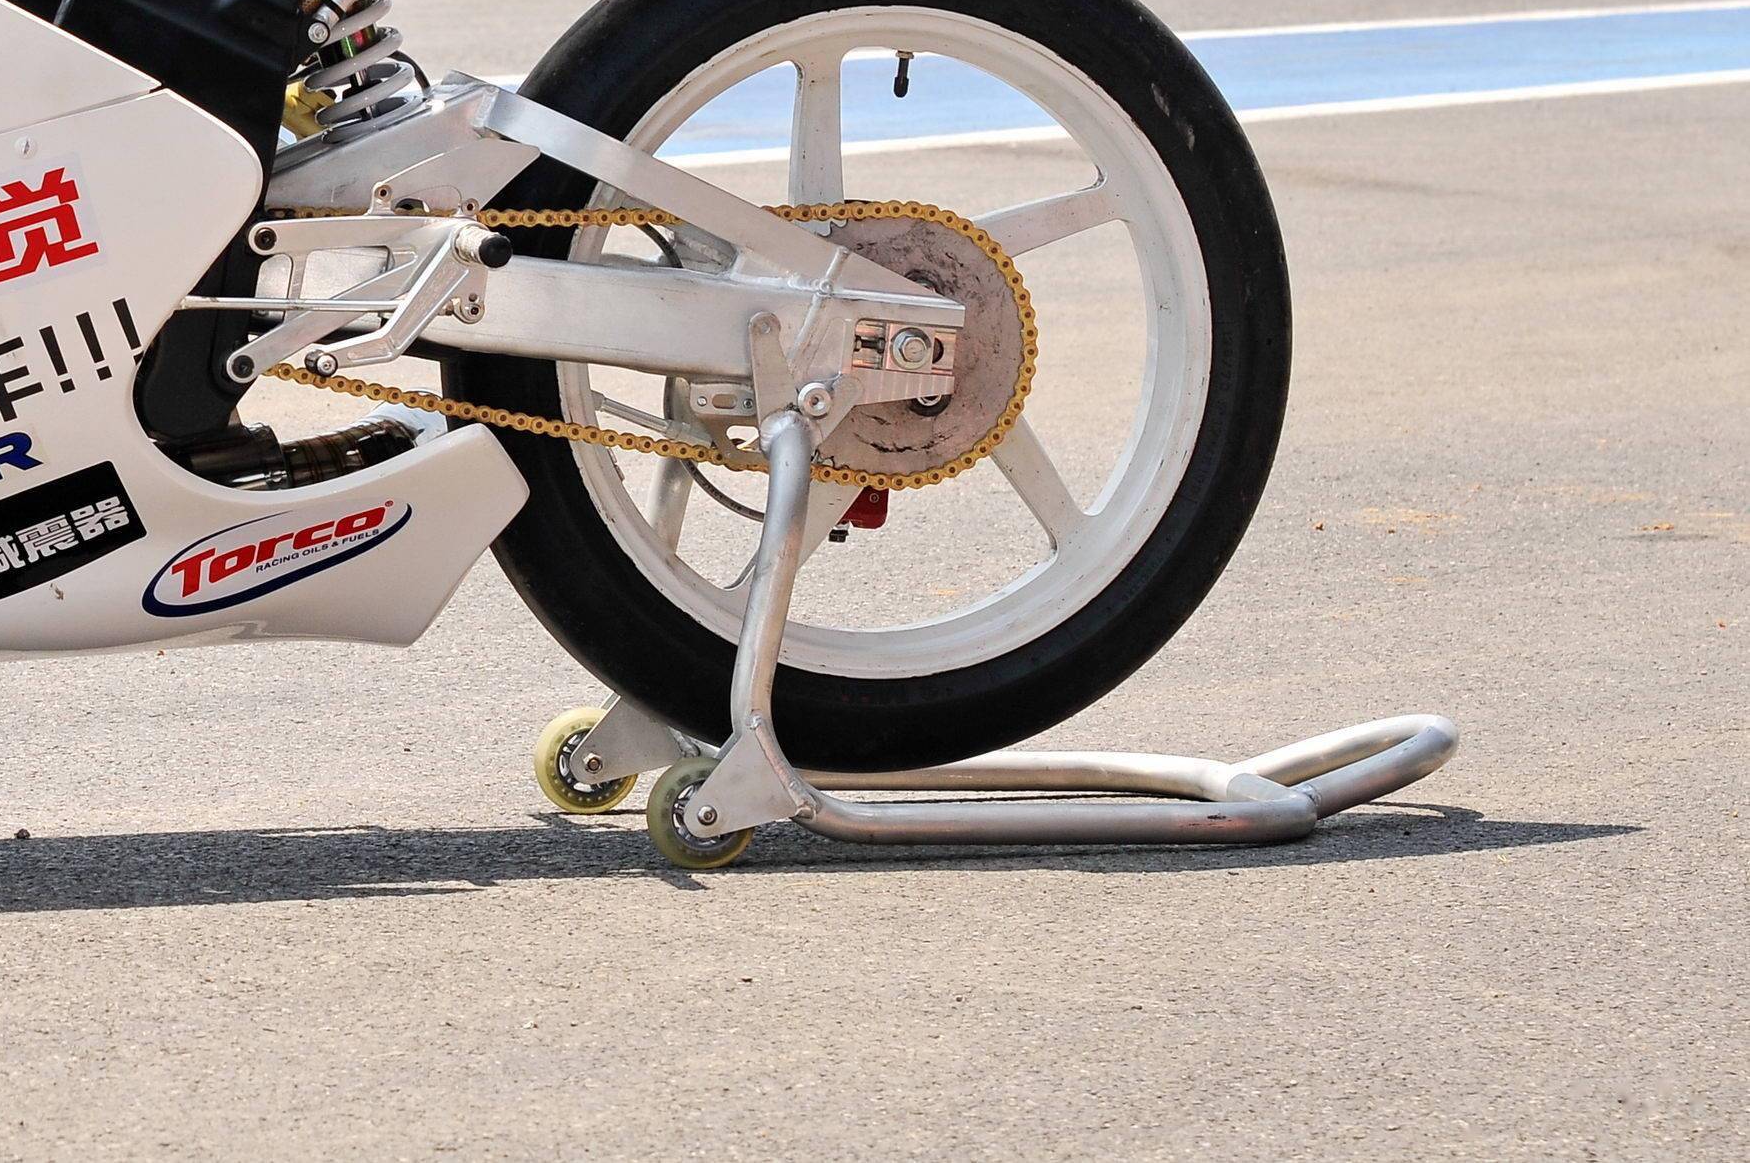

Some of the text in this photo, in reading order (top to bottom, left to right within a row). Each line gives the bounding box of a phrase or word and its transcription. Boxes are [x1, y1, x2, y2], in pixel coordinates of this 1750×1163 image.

[171, 506, 386, 598] Torco
[256, 551, 299, 573] RACING
[302, 541, 329, 556] OILS
[342, 528, 380, 545] FUELS
